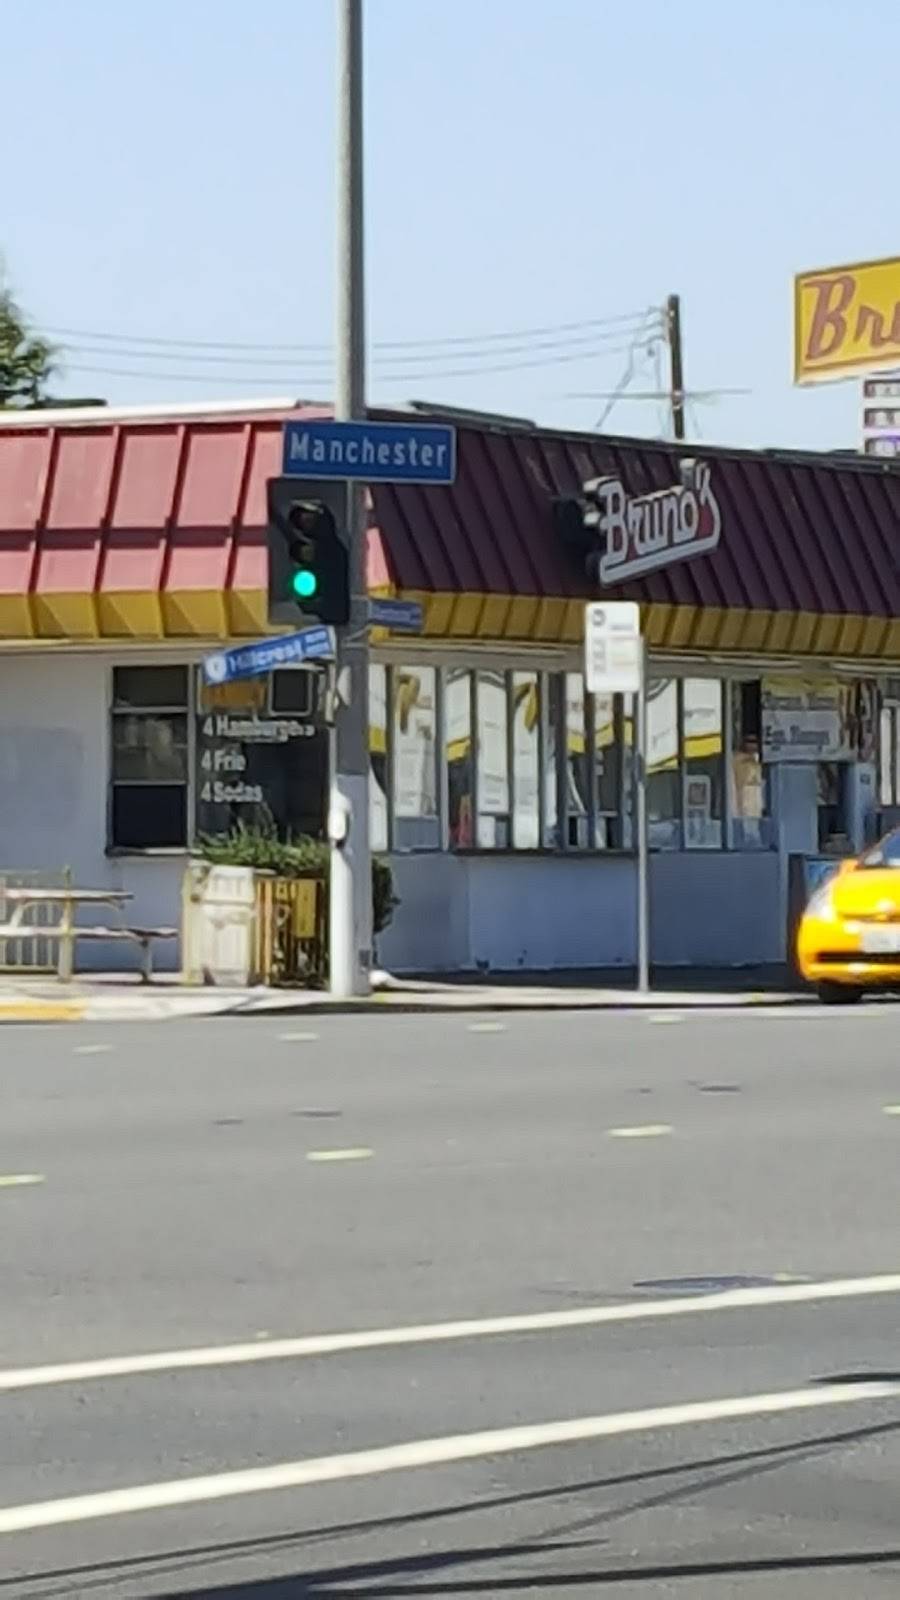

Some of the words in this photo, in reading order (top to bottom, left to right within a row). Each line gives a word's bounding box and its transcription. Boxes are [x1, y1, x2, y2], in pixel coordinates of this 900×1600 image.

[290, 432, 447, 467] Manchester
[598, 460, 721, 583] Bruno's
[202, 716, 214, 737] 4
[201, 750, 212, 771] 4
[201, 781, 212, 802] 4
